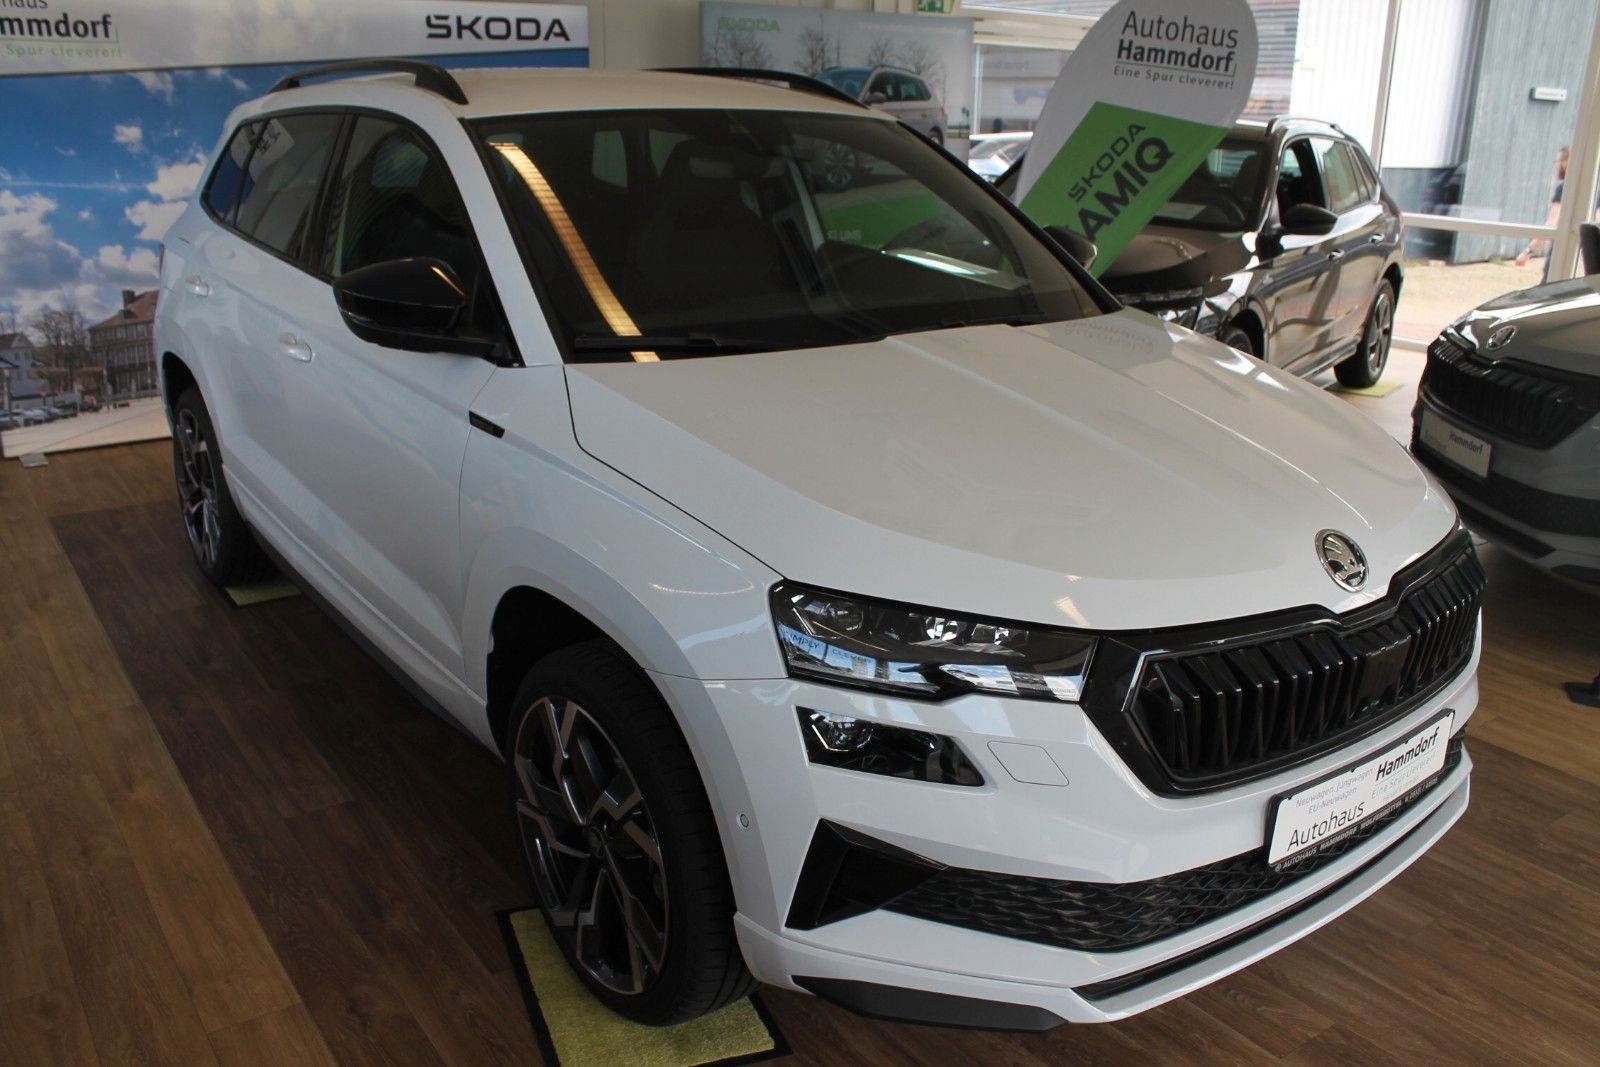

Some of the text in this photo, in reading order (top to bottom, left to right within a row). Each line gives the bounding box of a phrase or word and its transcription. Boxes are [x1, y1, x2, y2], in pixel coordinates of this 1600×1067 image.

[1121, 10, 1239, 49] Autohaus
[1117, 38, 1235, 73] Hammdorf
[1114, 65, 1234, 90] Eine Spur cleverer!
[1077, 137, 1175, 241] AMIQ
[1375, 726, 1440, 781] Hammdorf
[1287, 801, 1366, 852] Autohaus
[1282, 846, 1318, 870] AUTOHAUS
